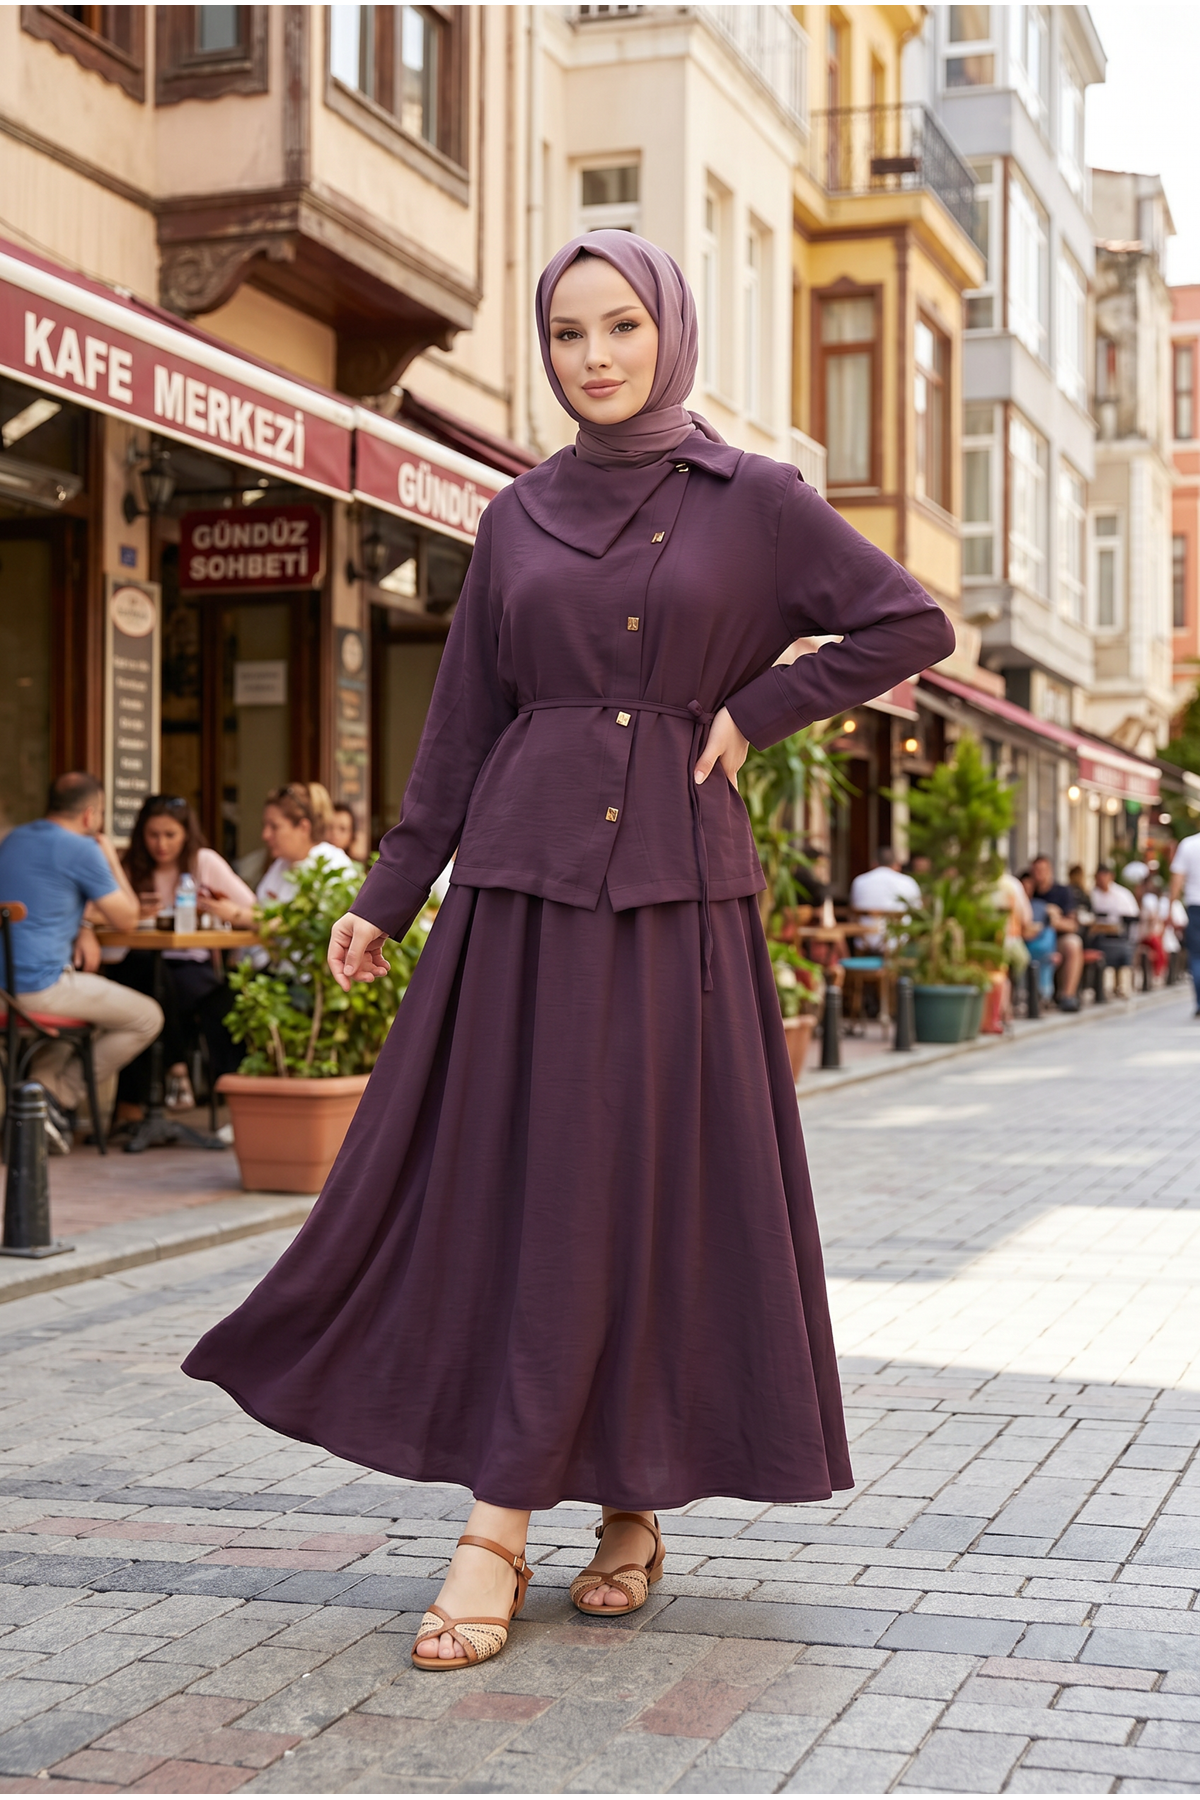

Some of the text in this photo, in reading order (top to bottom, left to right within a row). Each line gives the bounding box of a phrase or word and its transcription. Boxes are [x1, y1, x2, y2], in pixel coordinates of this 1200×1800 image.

[24, 310, 305, 470] KAFE MERKEZİ
[193, 518, 308, 548] GÜNDÜZ
[190, 549, 308, 580] SOHBETİ
